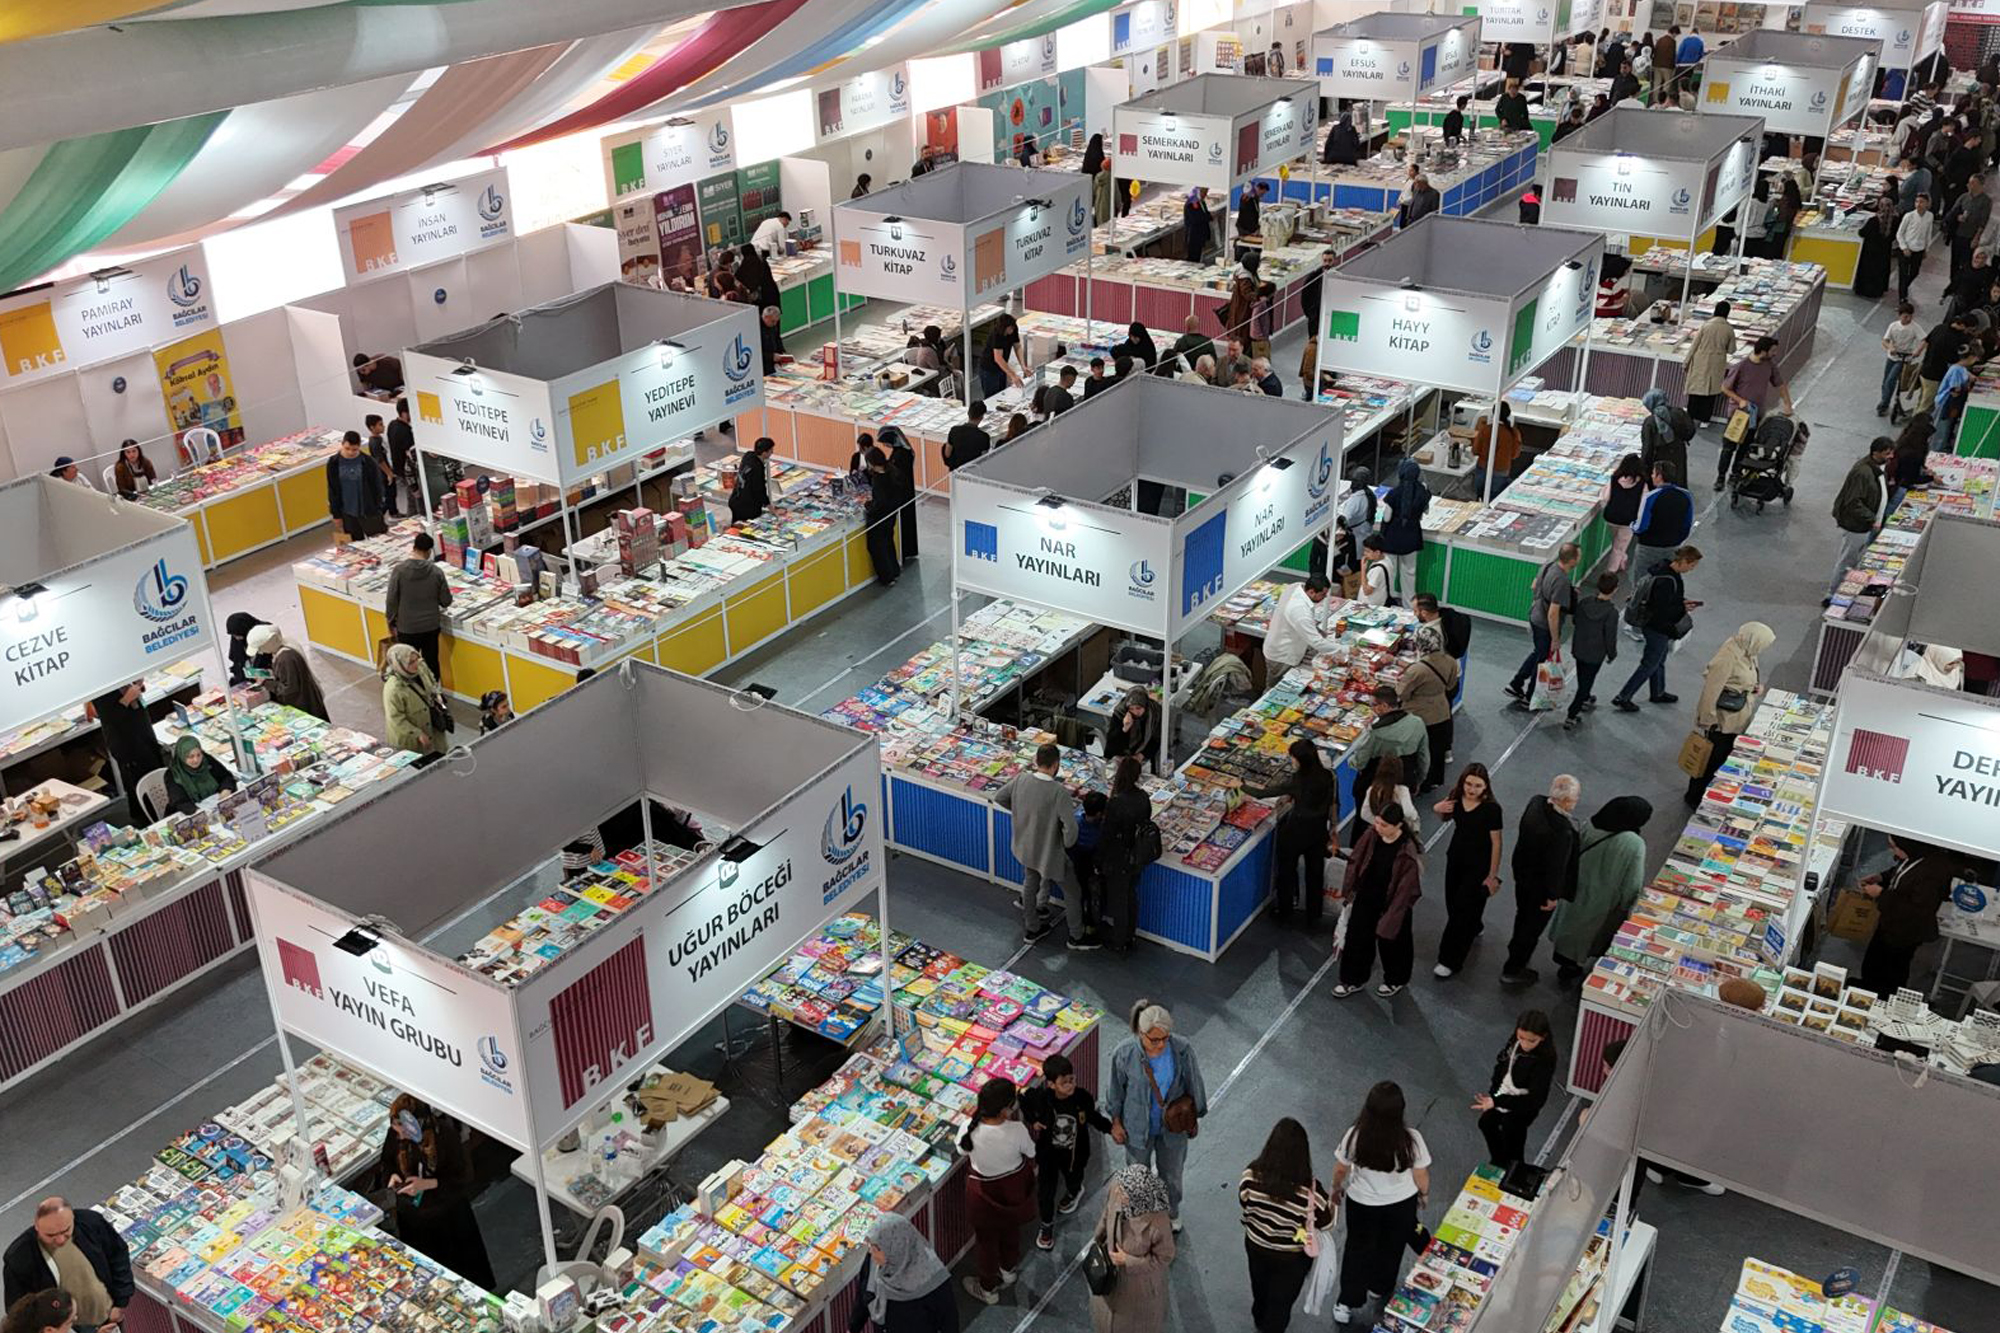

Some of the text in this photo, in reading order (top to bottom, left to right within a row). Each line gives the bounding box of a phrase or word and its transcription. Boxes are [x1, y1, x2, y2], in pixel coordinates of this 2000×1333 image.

[1486, 17, 1524, 25] YAYINLARI
[1841, 26, 1876, 36] DESTEK
[1351, 58, 1376, 68] EFSUS
[1342, 70, 1384, 80] YAYINLARI
[1750, 85, 1785, 98] İTHAKİ
[1738, 97, 1792, 110] YAYINLARI
[825, 121, 844, 136] BKF
[1142, 134, 1200, 150] SEMERKAND
[1148, 150, 1194, 163] YAYINLARI
[620, 177, 646, 195] BKF
[1612, 182, 1632, 194] TİN
[1589, 195, 1650, 211] YAYINLARI
[418, 212, 446, 228] İNSAN
[411, 224, 458, 245] YAYINLARI
[1015, 226, 1052, 250] TURKUVAZ
[366, 252, 399, 272] BKF
[870, 244, 926, 262] TURKUVAZ
[1024, 245, 1044, 262] KİTAP
[884, 260, 914, 276] KİTAP
[982, 273, 1006, 292] BKF
[80, 298, 134, 321] PAMİRAY
[172, 305, 207, 321] BAĞCILAR
[82, 312, 142, 340] YAYINLARI
[1392, 318, 1430, 335] HAYY
[1388, 334, 1430, 353] KİTAP
[20, 349, 63, 373] BKF
[645, 374, 696, 405] YEDİTEPE
[724, 378, 756, 398] BAĞCILAR
[454, 398, 509, 423] YEDİTEPE
[648, 391, 697, 423] YAYINEVİ
[458, 418, 510, 443] YAYINEVİ
[587, 434, 626, 462] BKF
[1254, 505, 1274, 527] NAR
[1304, 494, 1330, 518] BAĞCILAR
[1040, 536, 1077, 559] NAR
[1240, 516, 1286, 559] YAYINLARI
[971, 548, 998, 564] BKF
[1016, 552, 1101, 588] YAYINLARI
[1128, 585, 1155, 596] BAĞCILAR
[1190, 573, 1224, 608] BKF
[142, 614, 197, 644] BAĞCILAR
[144, 625, 200, 655] BELEDİYESİ
[5, 626, 68, 663] CEZVE
[14, 651, 70, 687] KİTAP
[1857, 764, 1901, 784] BKF
[822, 850, 870, 895] BAĞCILAR
[823, 864, 870, 907] BELEDİYESİ
[668, 858, 794, 969] UĞUR BÖCEĞİ
[686, 901, 780, 984] YAYINLARI
[292, 976, 323, 1000] BKF
[362, 976, 416, 1018] VEFA
[328, 986, 463, 1068] YAYIN GRUBU
[581, 1023, 656, 1093] BKF
[480, 1066, 512, 1090] BAĞCILAR
